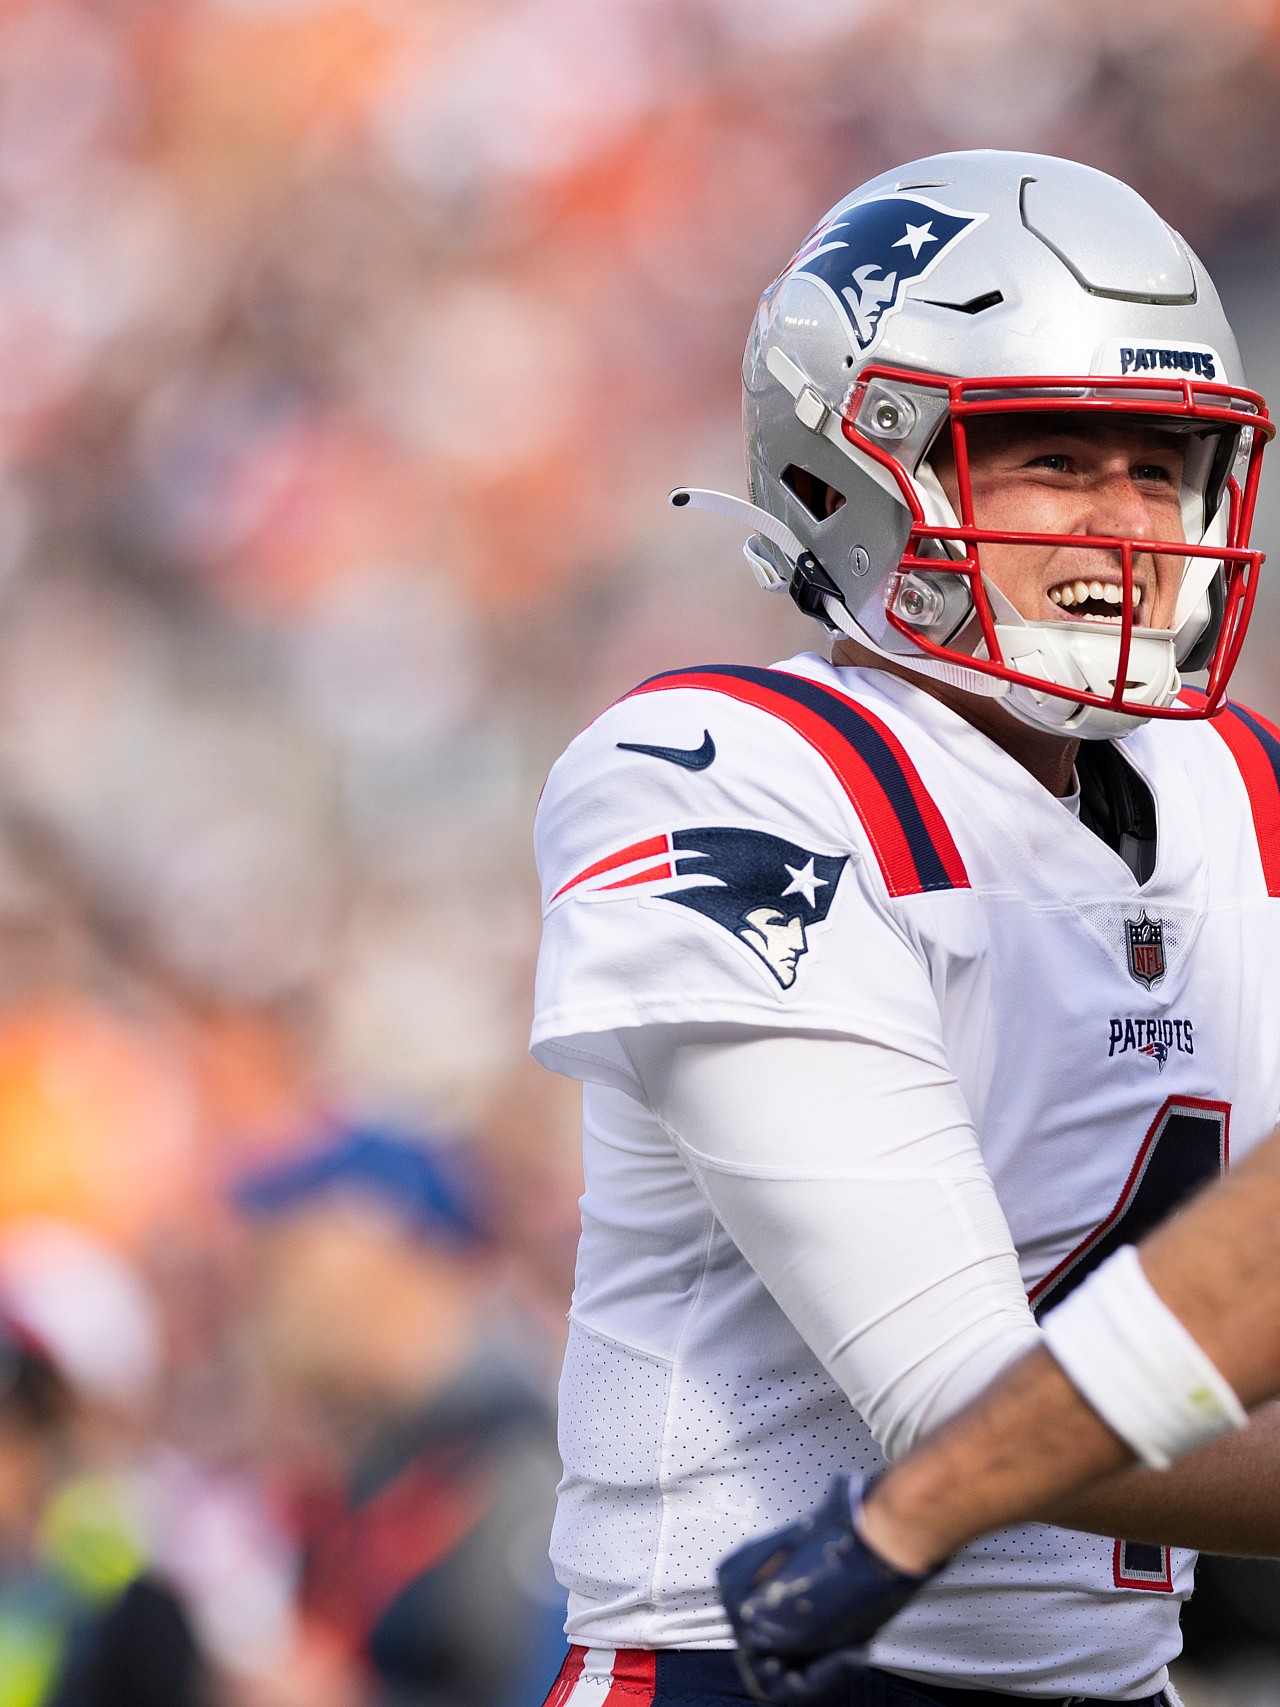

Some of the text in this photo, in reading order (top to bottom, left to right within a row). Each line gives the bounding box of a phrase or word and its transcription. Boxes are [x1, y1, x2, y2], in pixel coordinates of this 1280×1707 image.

[1119, 347, 1216, 381] PATRIOTS
[1135, 945, 1163, 975] NFL
[1108, 1018, 1194, 1057] PATRIOTS
